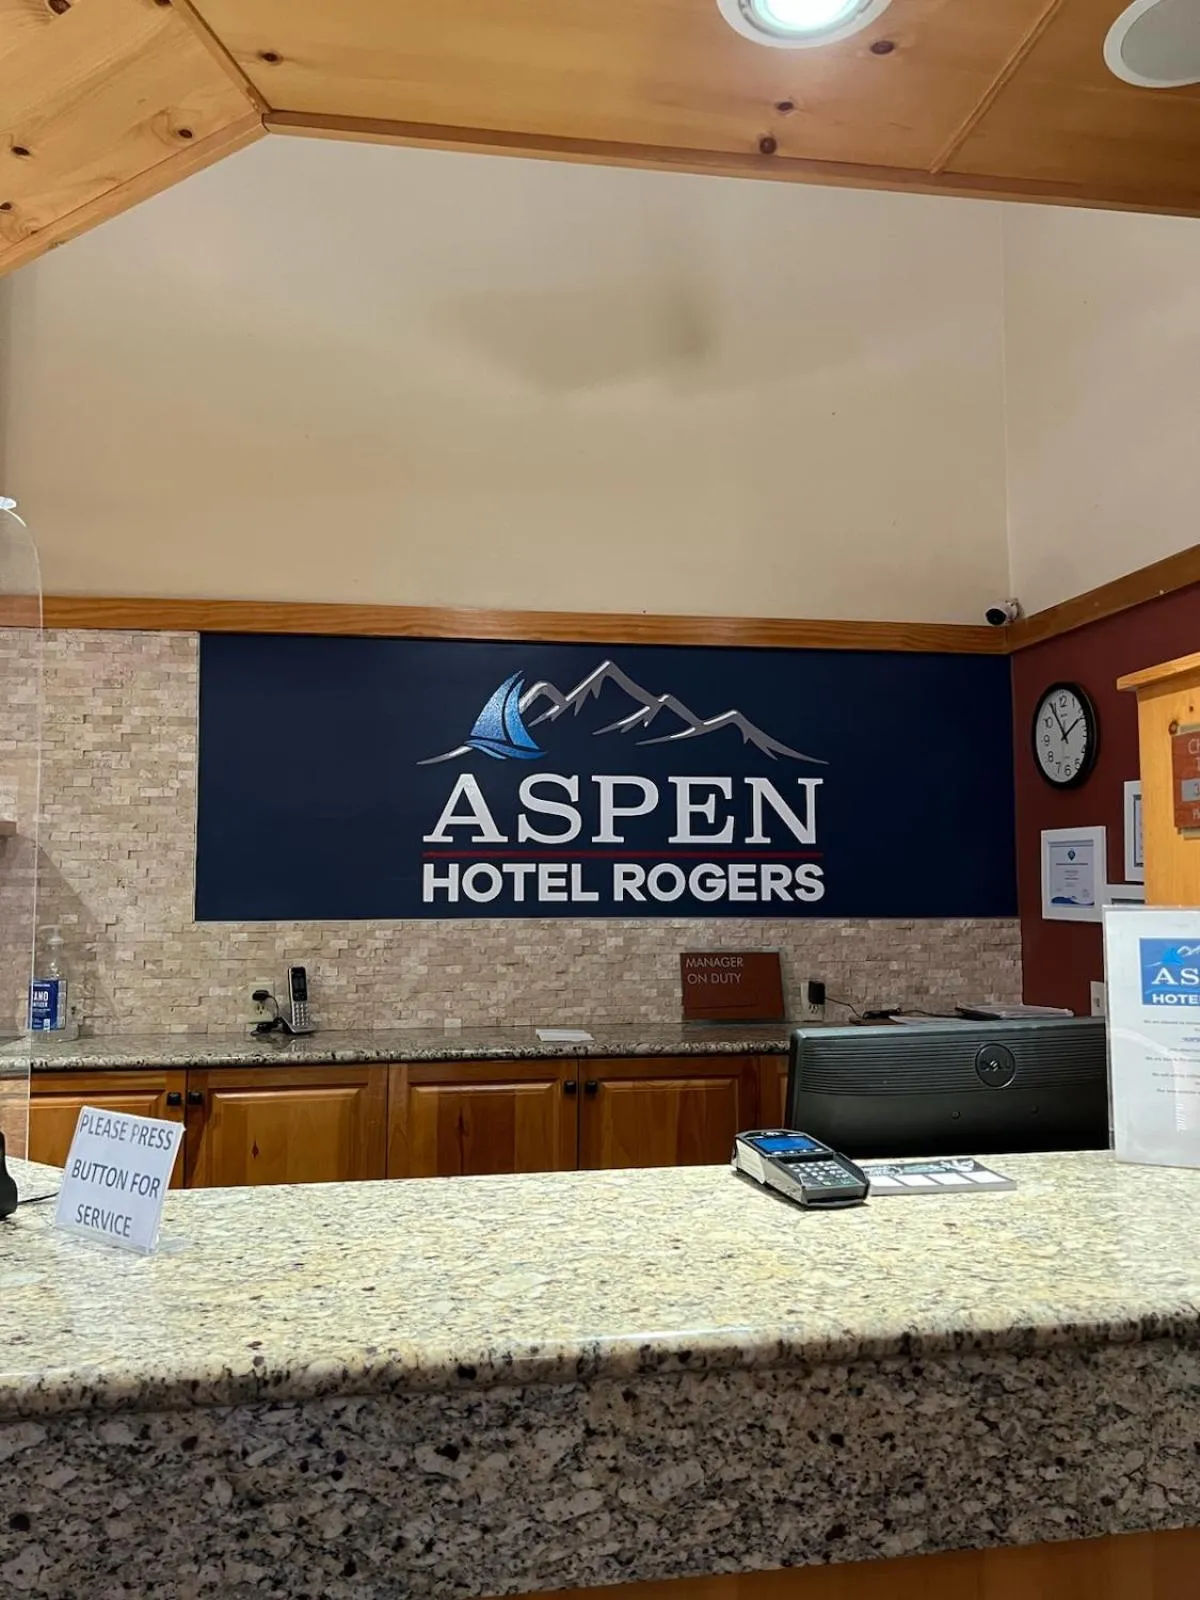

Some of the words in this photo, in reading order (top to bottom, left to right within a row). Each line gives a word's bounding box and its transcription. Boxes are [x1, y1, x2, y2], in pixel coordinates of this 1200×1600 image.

[1058, 695, 1067, 708] 12
[1043, 716, 1053, 729] 10
[1043, 734, 1050, 747] 9
[1047, 751, 1053, 763] 8
[1064, 764, 1071, 777] 6
[422, 773, 825, 845] ASPEN
[422, 863, 600, 903] HOTEL
[613, 863, 826, 903] ROGERS
[686, 957, 744, 968] MANAGER
[687, 973, 707, 984] ON
[711, 973, 742, 984] DUTY
[80, 1114, 129, 1141] PLEASE
[129, 1123, 174, 1151] PRESS
[72, 1159, 129, 1191] BUTTON
[129, 1172, 161, 1199] FOR
[75, 1204, 132, 1238] SERVICE
